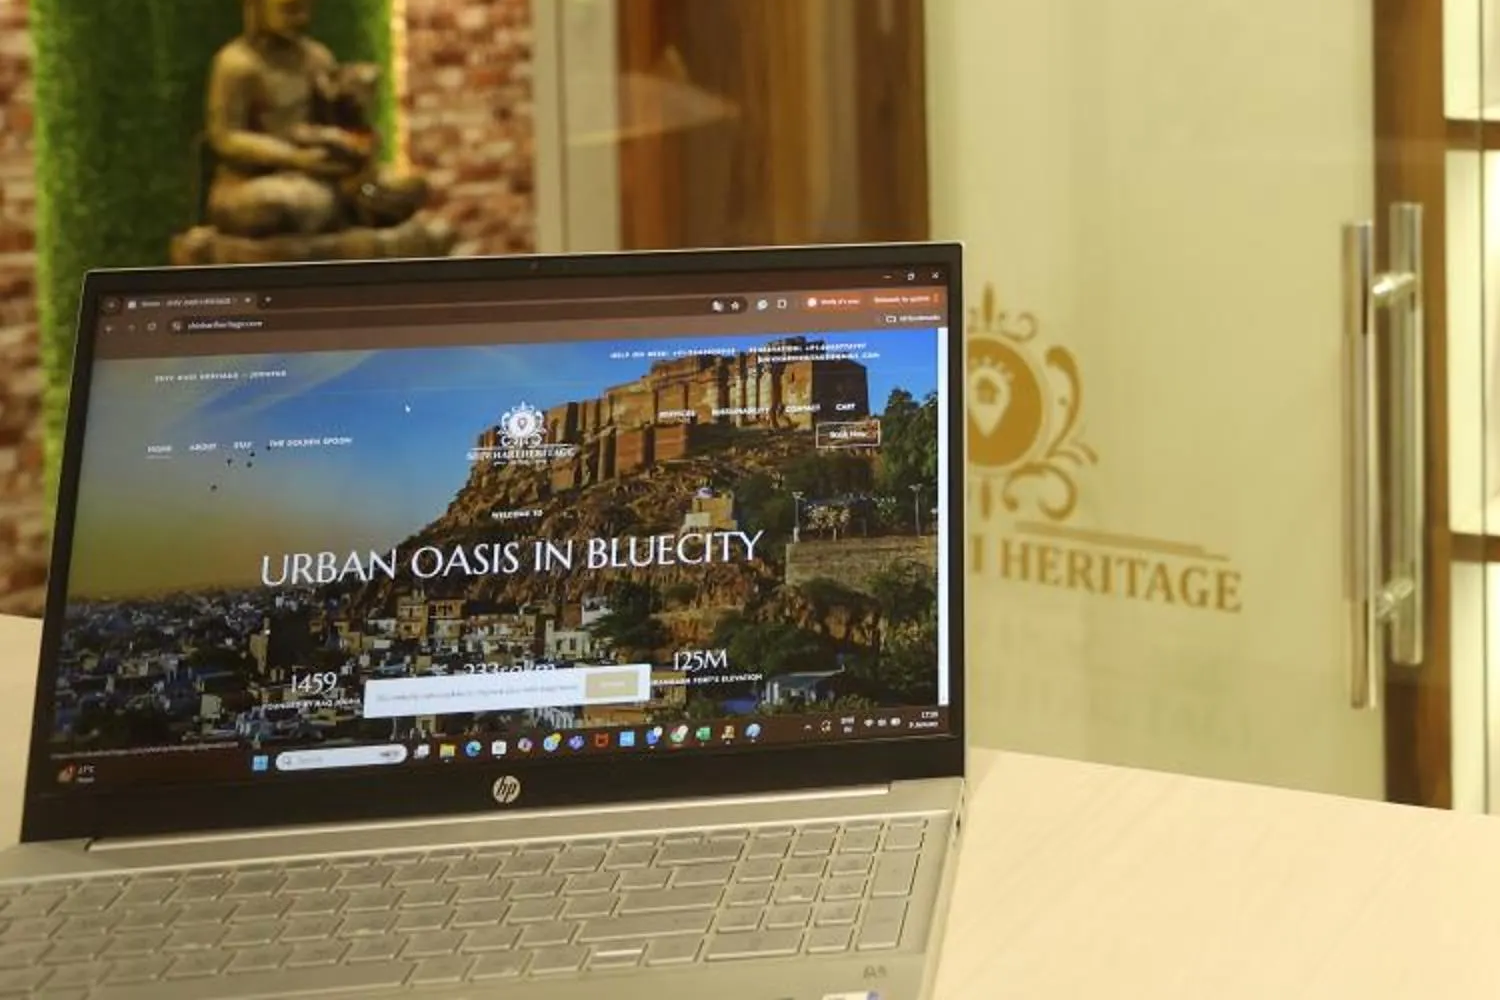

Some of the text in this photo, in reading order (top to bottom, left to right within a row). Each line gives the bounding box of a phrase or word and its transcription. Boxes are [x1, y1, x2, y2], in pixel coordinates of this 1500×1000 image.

[261, 530, 765, 587] URBAN OASIS IN BLUECITY
[1001, 541, 1243, 614] HERITAGE
[674, 648, 728, 671] 125M
[291, 671, 338, 693] 1459
